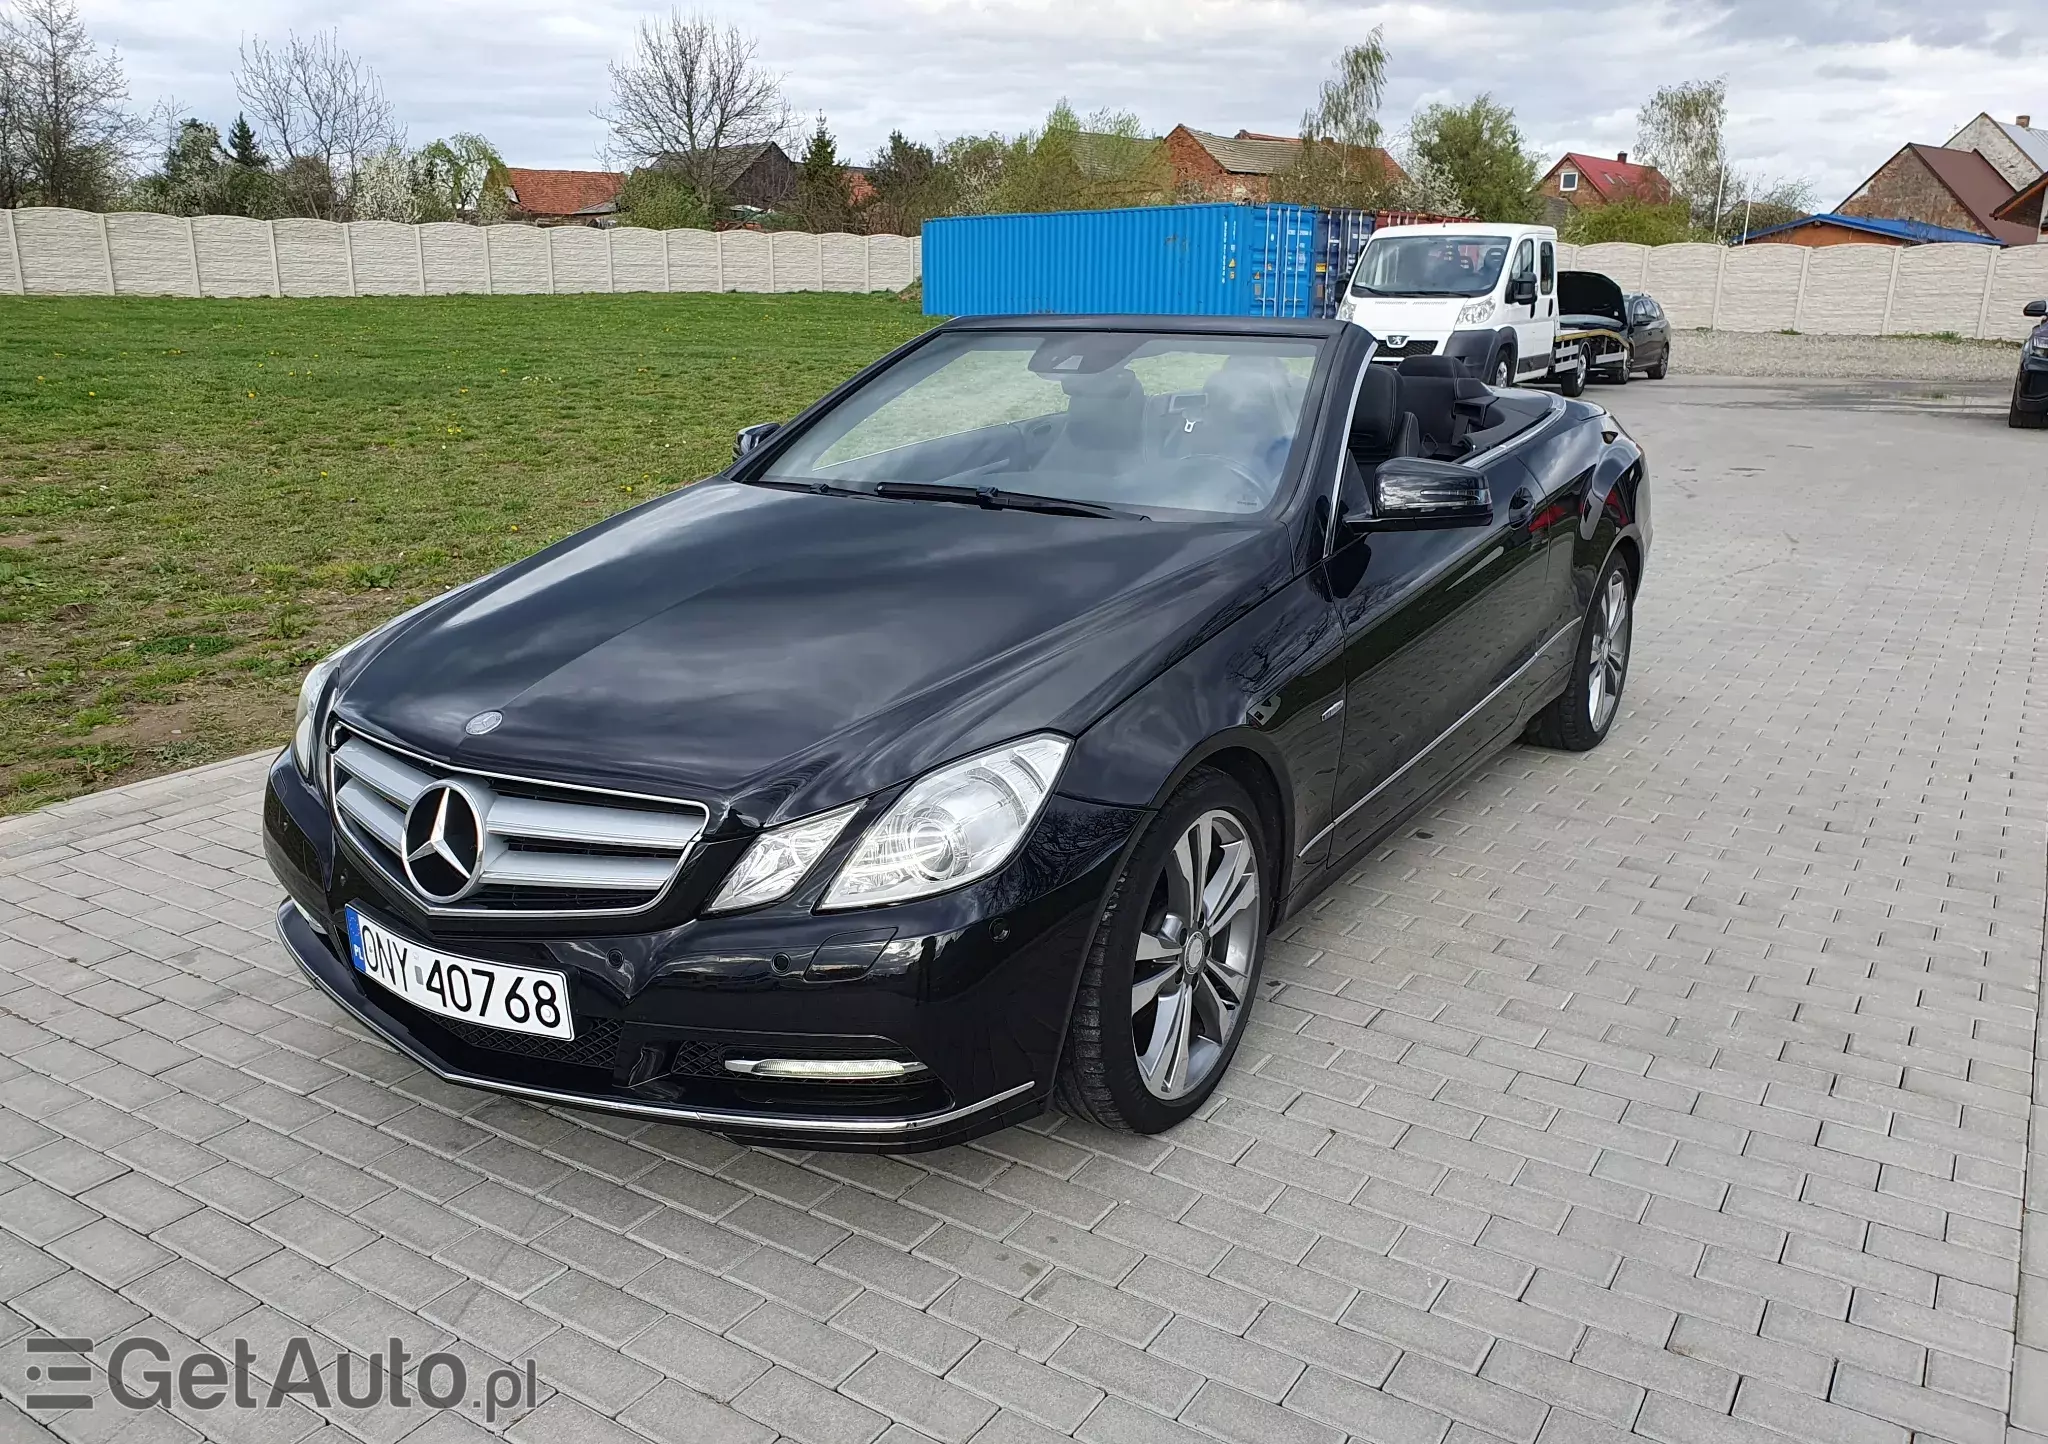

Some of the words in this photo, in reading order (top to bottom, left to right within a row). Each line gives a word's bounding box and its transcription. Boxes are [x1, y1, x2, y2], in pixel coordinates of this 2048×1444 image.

[353, 943, 364, 961] PL
[362, 925, 408, 993] ONY
[426, 959, 561, 1029] 40768
